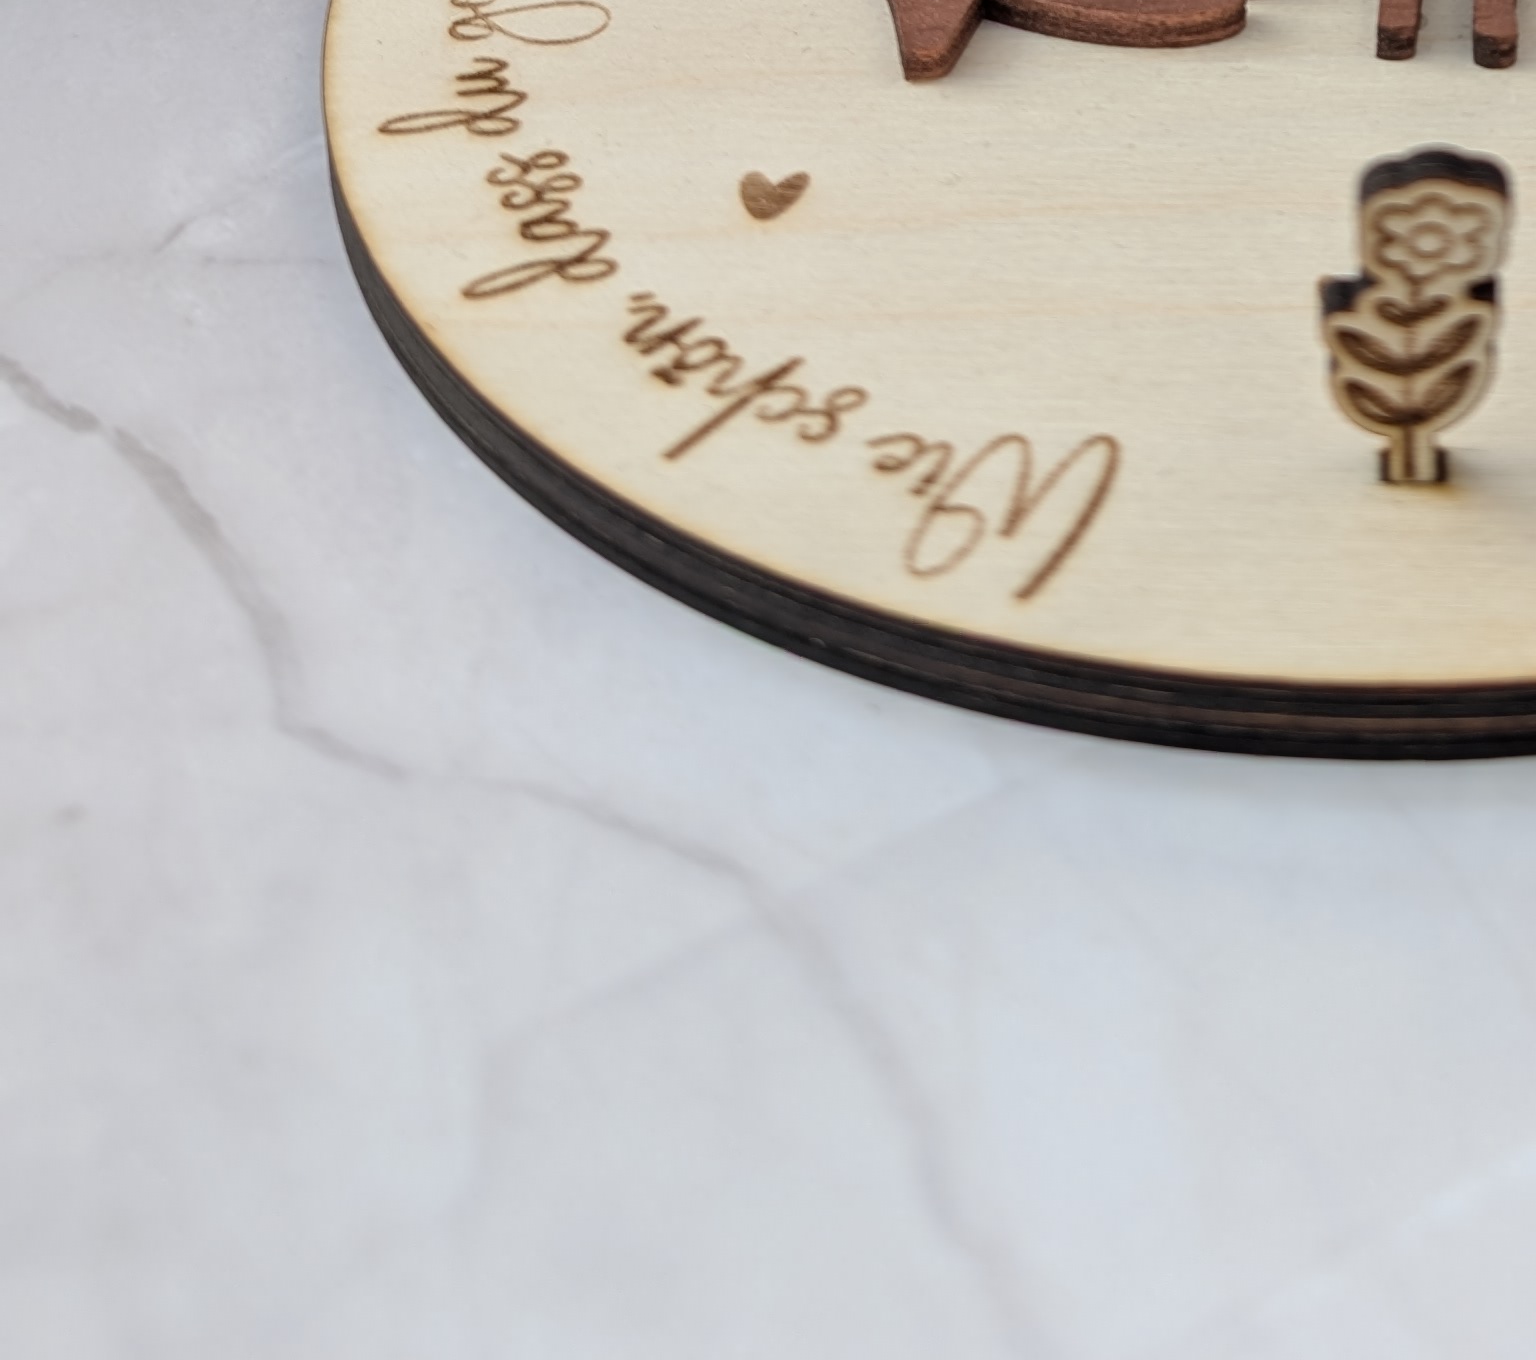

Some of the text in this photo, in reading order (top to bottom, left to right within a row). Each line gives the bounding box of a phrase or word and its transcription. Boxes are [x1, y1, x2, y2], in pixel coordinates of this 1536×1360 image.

[377, 55, 528, 138] du
[459, 148, 620, 300] dass
[865, 431, 1123, 602] Wie
